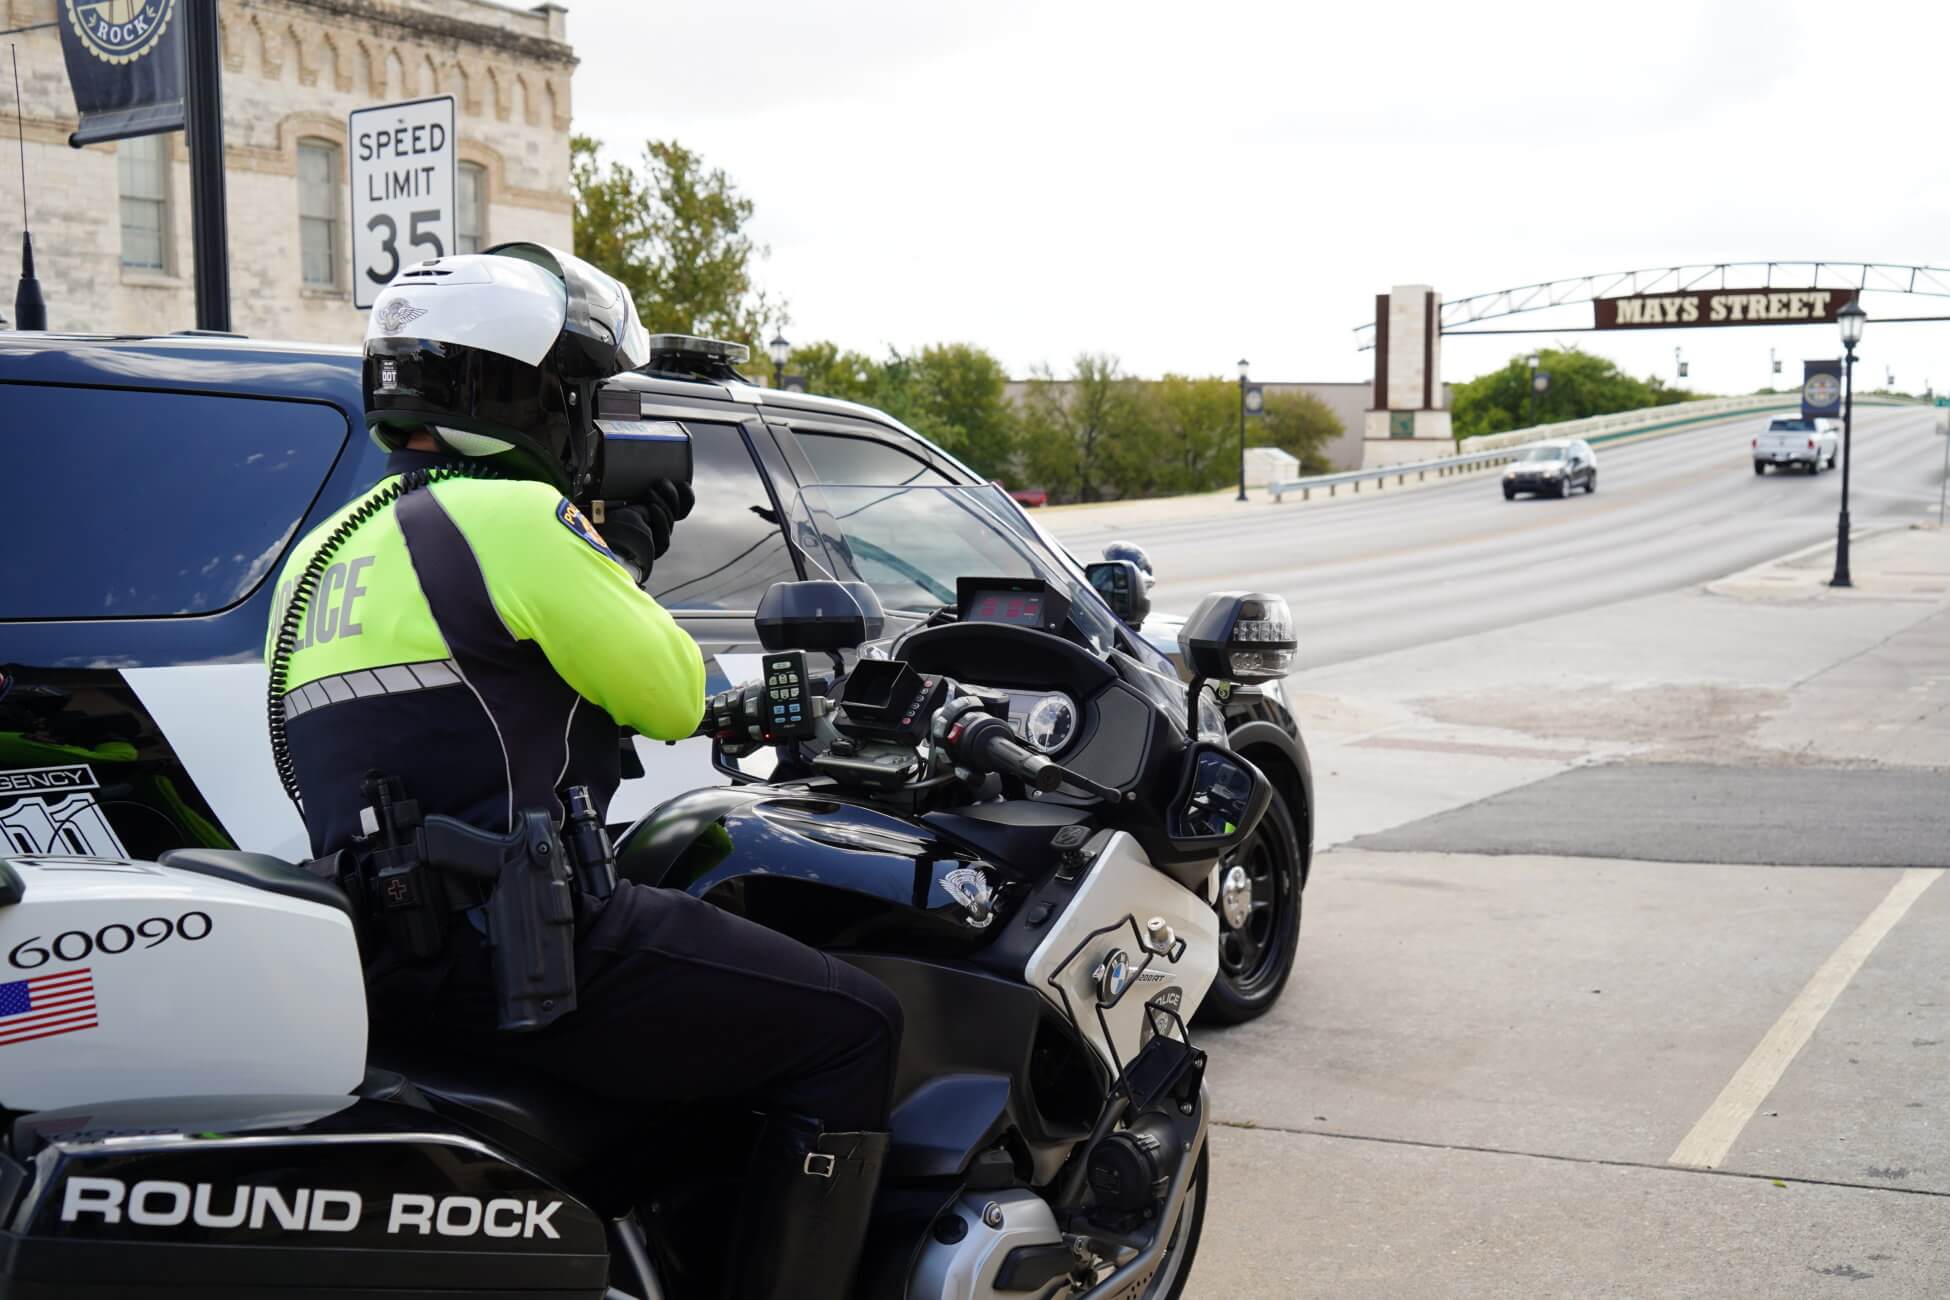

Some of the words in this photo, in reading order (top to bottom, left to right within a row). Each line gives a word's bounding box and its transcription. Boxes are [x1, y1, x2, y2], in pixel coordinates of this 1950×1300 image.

[97, 14, 149, 43] ROCK
[359, 123, 445, 161] SPEED
[369, 167, 435, 202] LIMIT
[366, 209, 444, 285] 35
[1616, 297, 1699, 324] MAYS
[1710, 292, 1831, 321] STREET
[382, 371, 397, 382] DOT
[269, 556, 376, 654] OLICE
[0, 793, 131, 859] 11
[8, 911, 212, 969] 60090
[1153, 992, 1180, 1006] OLICE
[60, 1176, 362, 1233] ROUND
[387, 1193, 563, 1239] ROCK
